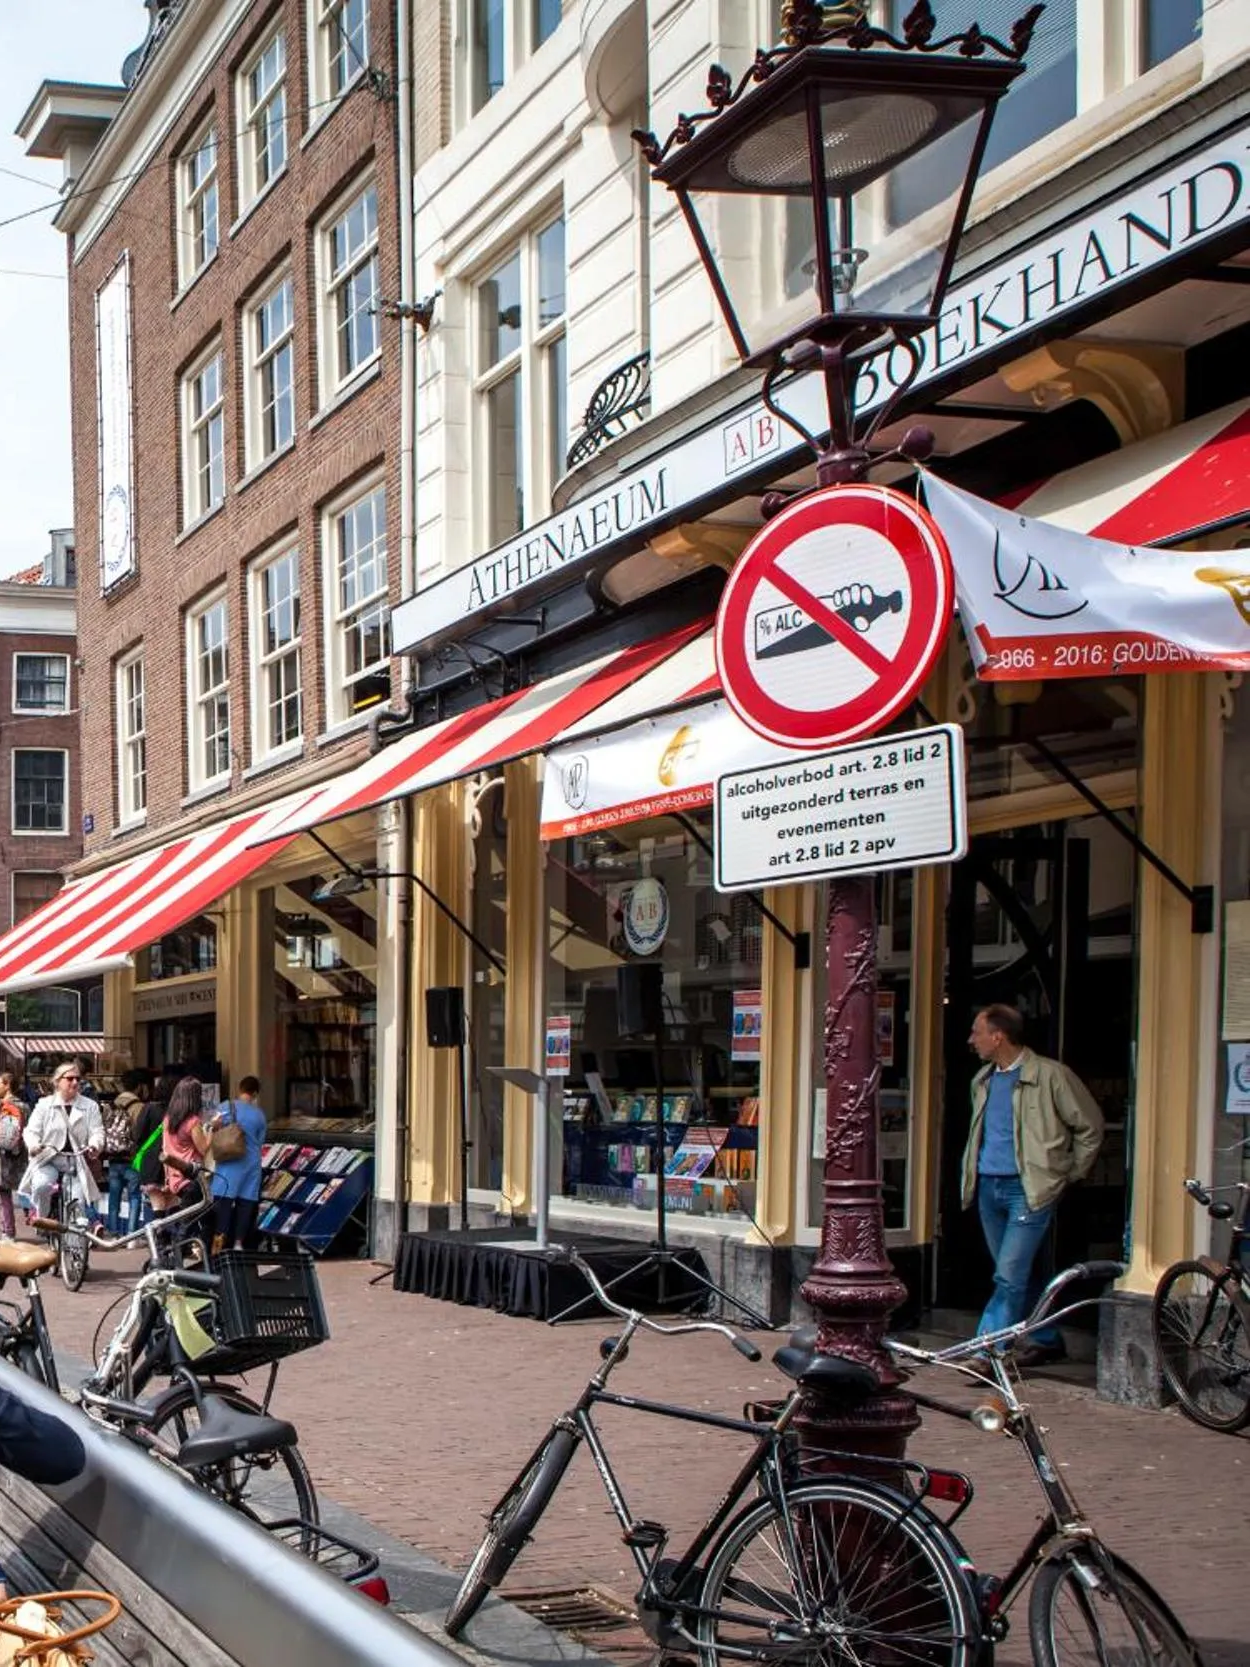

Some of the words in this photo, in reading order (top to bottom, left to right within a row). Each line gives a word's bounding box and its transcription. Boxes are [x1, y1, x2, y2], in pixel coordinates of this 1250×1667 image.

[851, 147, 1250, 410] BOEKHAND
[467, 467, 669, 611] ATHENAEUM
[775, 610, 802, 632] ALC
[1054, 647, 1107, 666] 2016:
[726, 764, 834, 798] alcoholverbod
[839, 760, 867, 776] art.
[873, 752, 898, 770] 2.8
[904, 745, 924, 764] lid
[931, 742, 941, 759] 2
[741, 789, 844, 821] uitgezonderd
[849, 781, 898, 801] terras
[904, 777, 925, 791] en
[777, 811, 886, 840] evenementen
[768, 852, 791, 867] art
[795, 847, 820, 863] 2.8
[824, 841, 844, 859] lid
[850, 840, 859, 853] 2
[865, 836, 896, 855] apv
